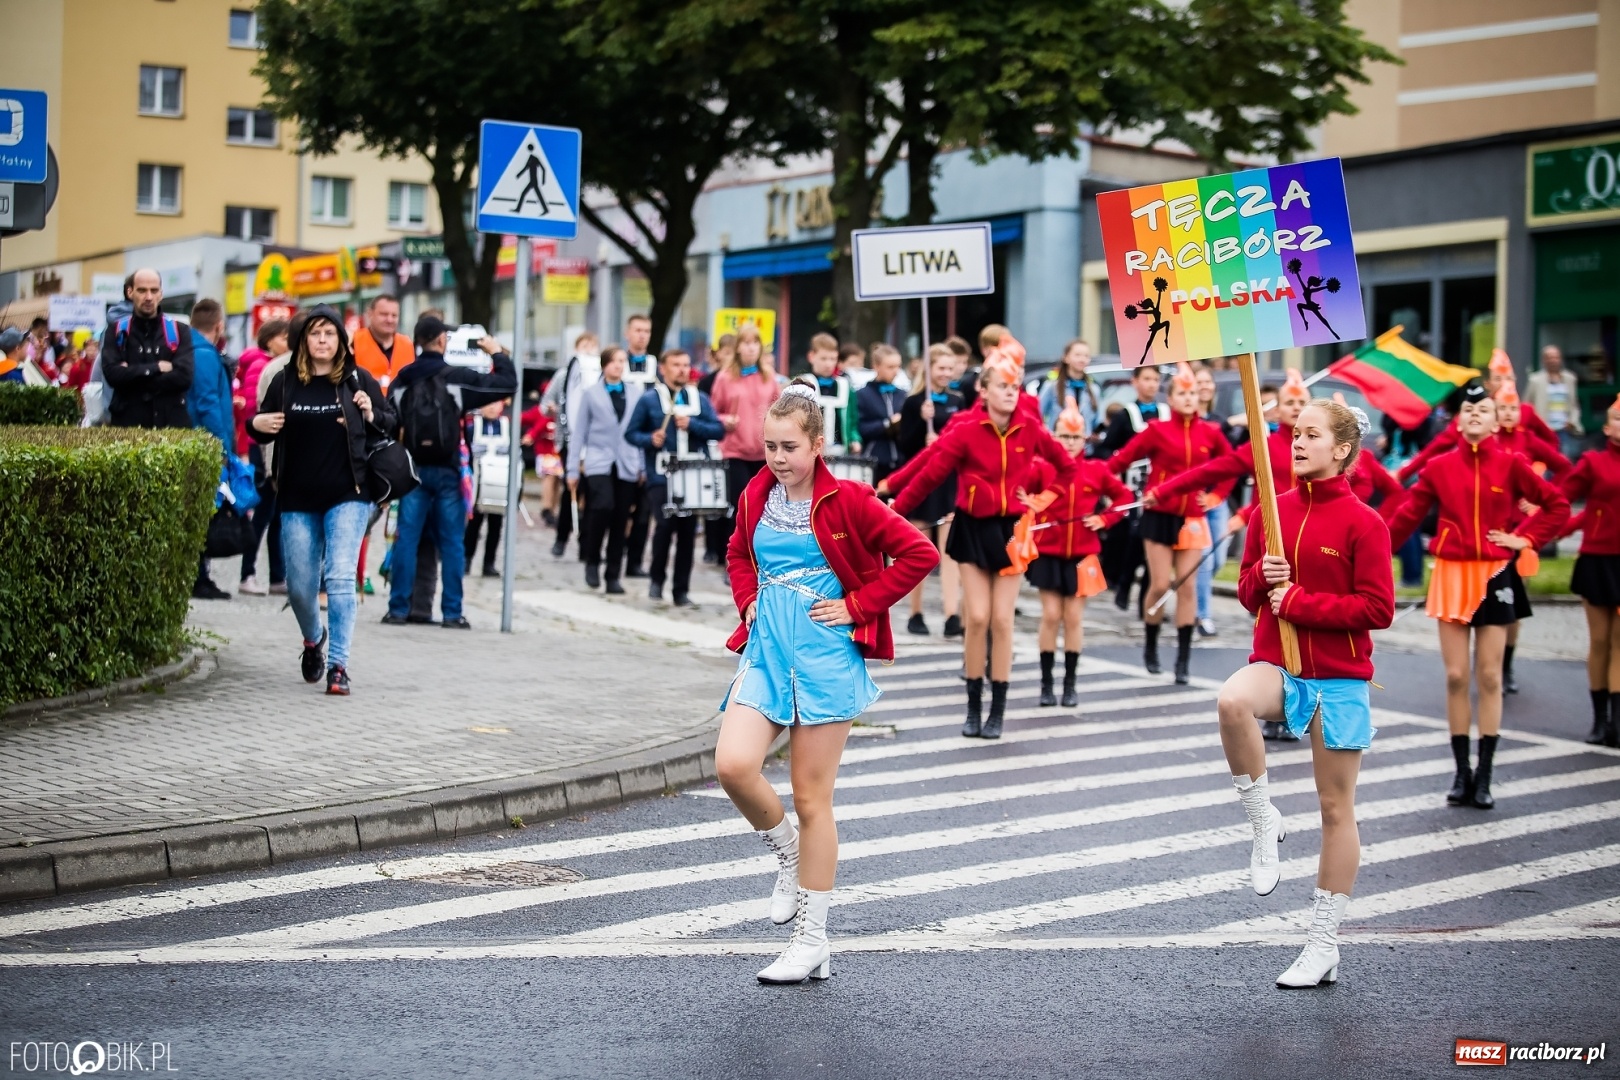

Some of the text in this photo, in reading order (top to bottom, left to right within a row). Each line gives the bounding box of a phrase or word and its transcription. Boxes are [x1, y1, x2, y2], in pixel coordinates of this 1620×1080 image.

[1131, 179, 1311, 231] TĘCZA
[884, 250, 961, 275] LITWA
[1125, 225, 1331, 275] RACIBÓRZ
[1170, 276, 1296, 314] POLSKA
